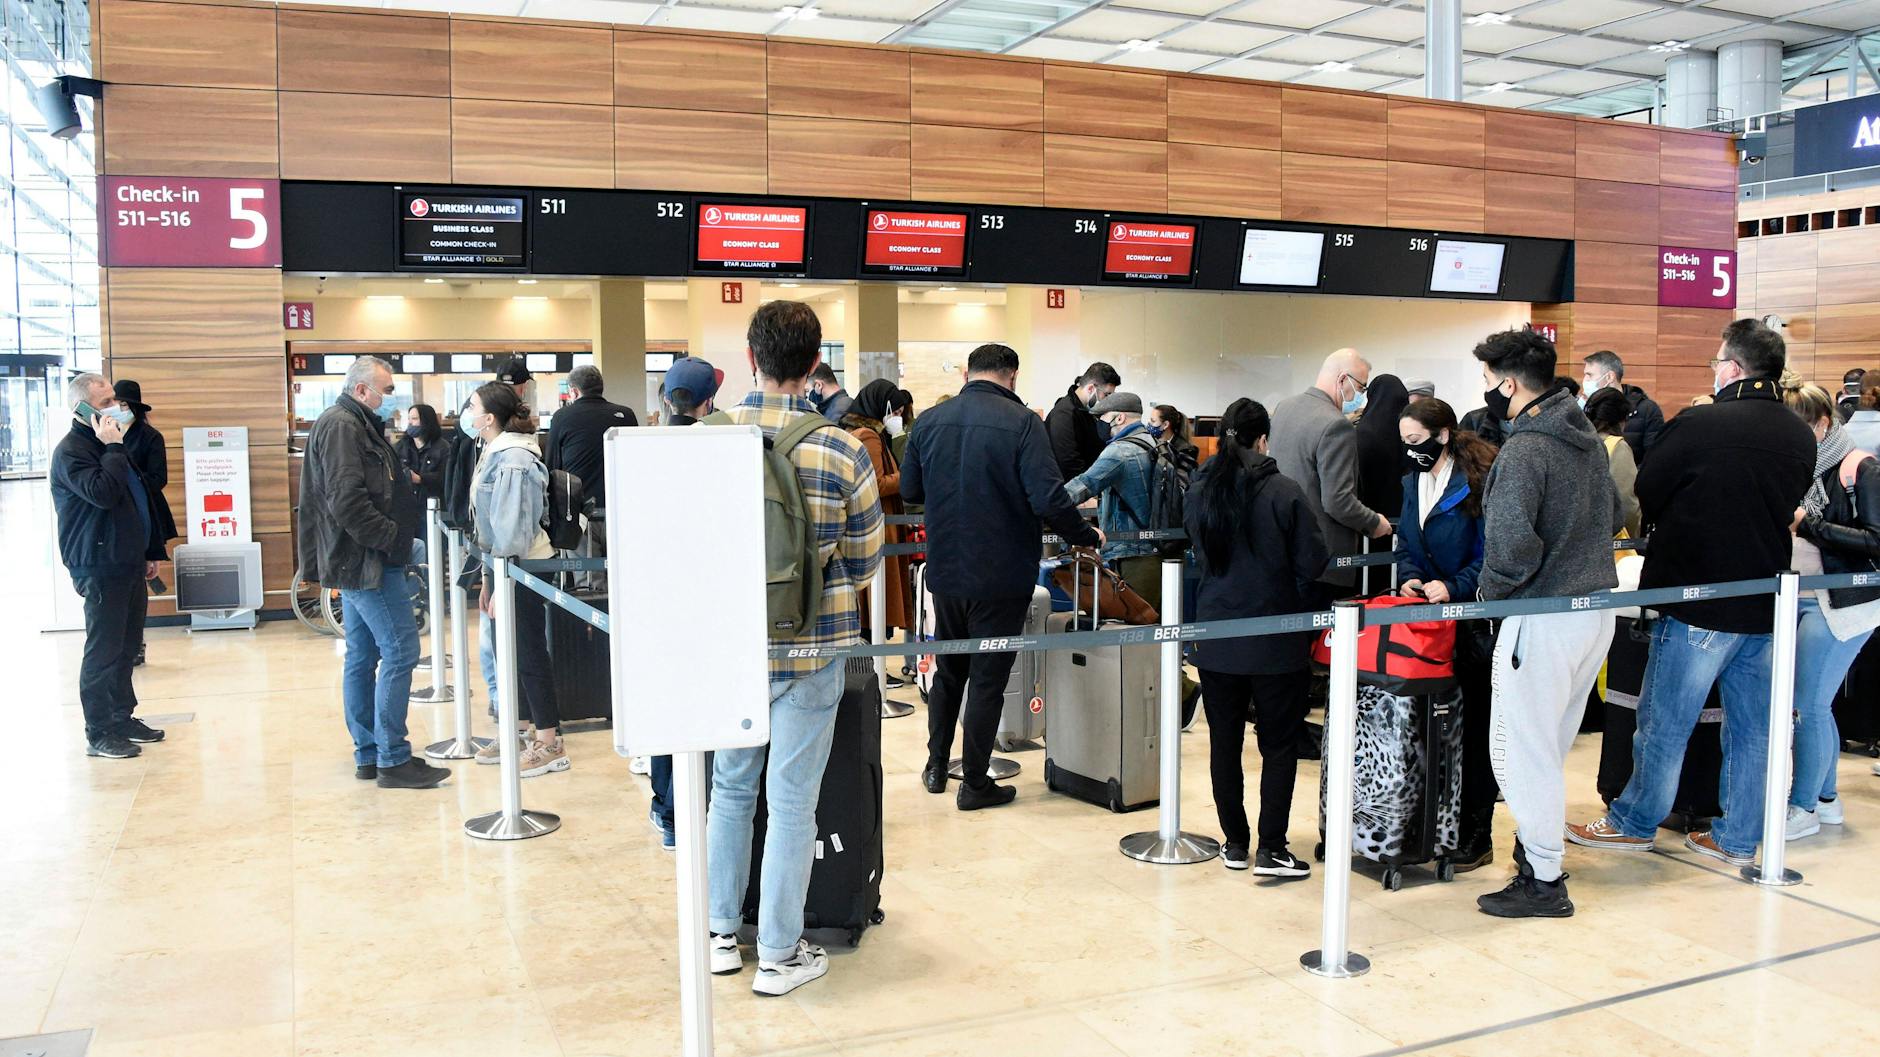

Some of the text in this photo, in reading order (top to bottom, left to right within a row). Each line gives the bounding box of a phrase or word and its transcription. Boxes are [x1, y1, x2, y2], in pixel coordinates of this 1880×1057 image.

[117, 185, 200, 203] Check-in
[431, 203, 517, 215] TURKISH AIRLINES
[540, 198, 566, 214] 511
[657, 202, 684, 218] 512
[229, 187, 268, 249] 5
[724, 212, 800, 223] TURKISH AIRLINES
[891, 218, 961, 229] TURKISH AIRLINES
[981, 214, 1004, 230] 513
[432, 225, 494, 234] BUSINESS CLASS
[1074, 219, 1097, 234] 514
[1128, 229, 1190, 240] TURKISH AIRLINES
[1334, 233, 1354, 247] 515
[430, 240, 463, 248] COMMON
[722, 240, 780, 249] ECONOMY CLASS
[888, 245, 942, 254] ECONOMY CLASS
[1409, 238, 1428, 251] 516
[1125, 254, 1172, 263] ECONOMY CLASS
[1663, 252, 1700, 265] Check-in
[1712, 256, 1731, 297] 5
[1042, 535, 1058, 544] BER
[1139, 531, 1154, 540] BER
[1613, 540, 1622, 549] ER
[1336, 557, 1352, 567] BER
[1853, 574, 1868, 585] BER
[1683, 587, 1700, 599] BER
[1571, 597, 1590, 609] BER
[1442, 605, 1463, 618] BER
[1312, 614, 1334, 627] BER
[1153, 626, 1180, 640] BER
[979, 638, 1009, 650] BER
[787, 648, 820, 658] BER
